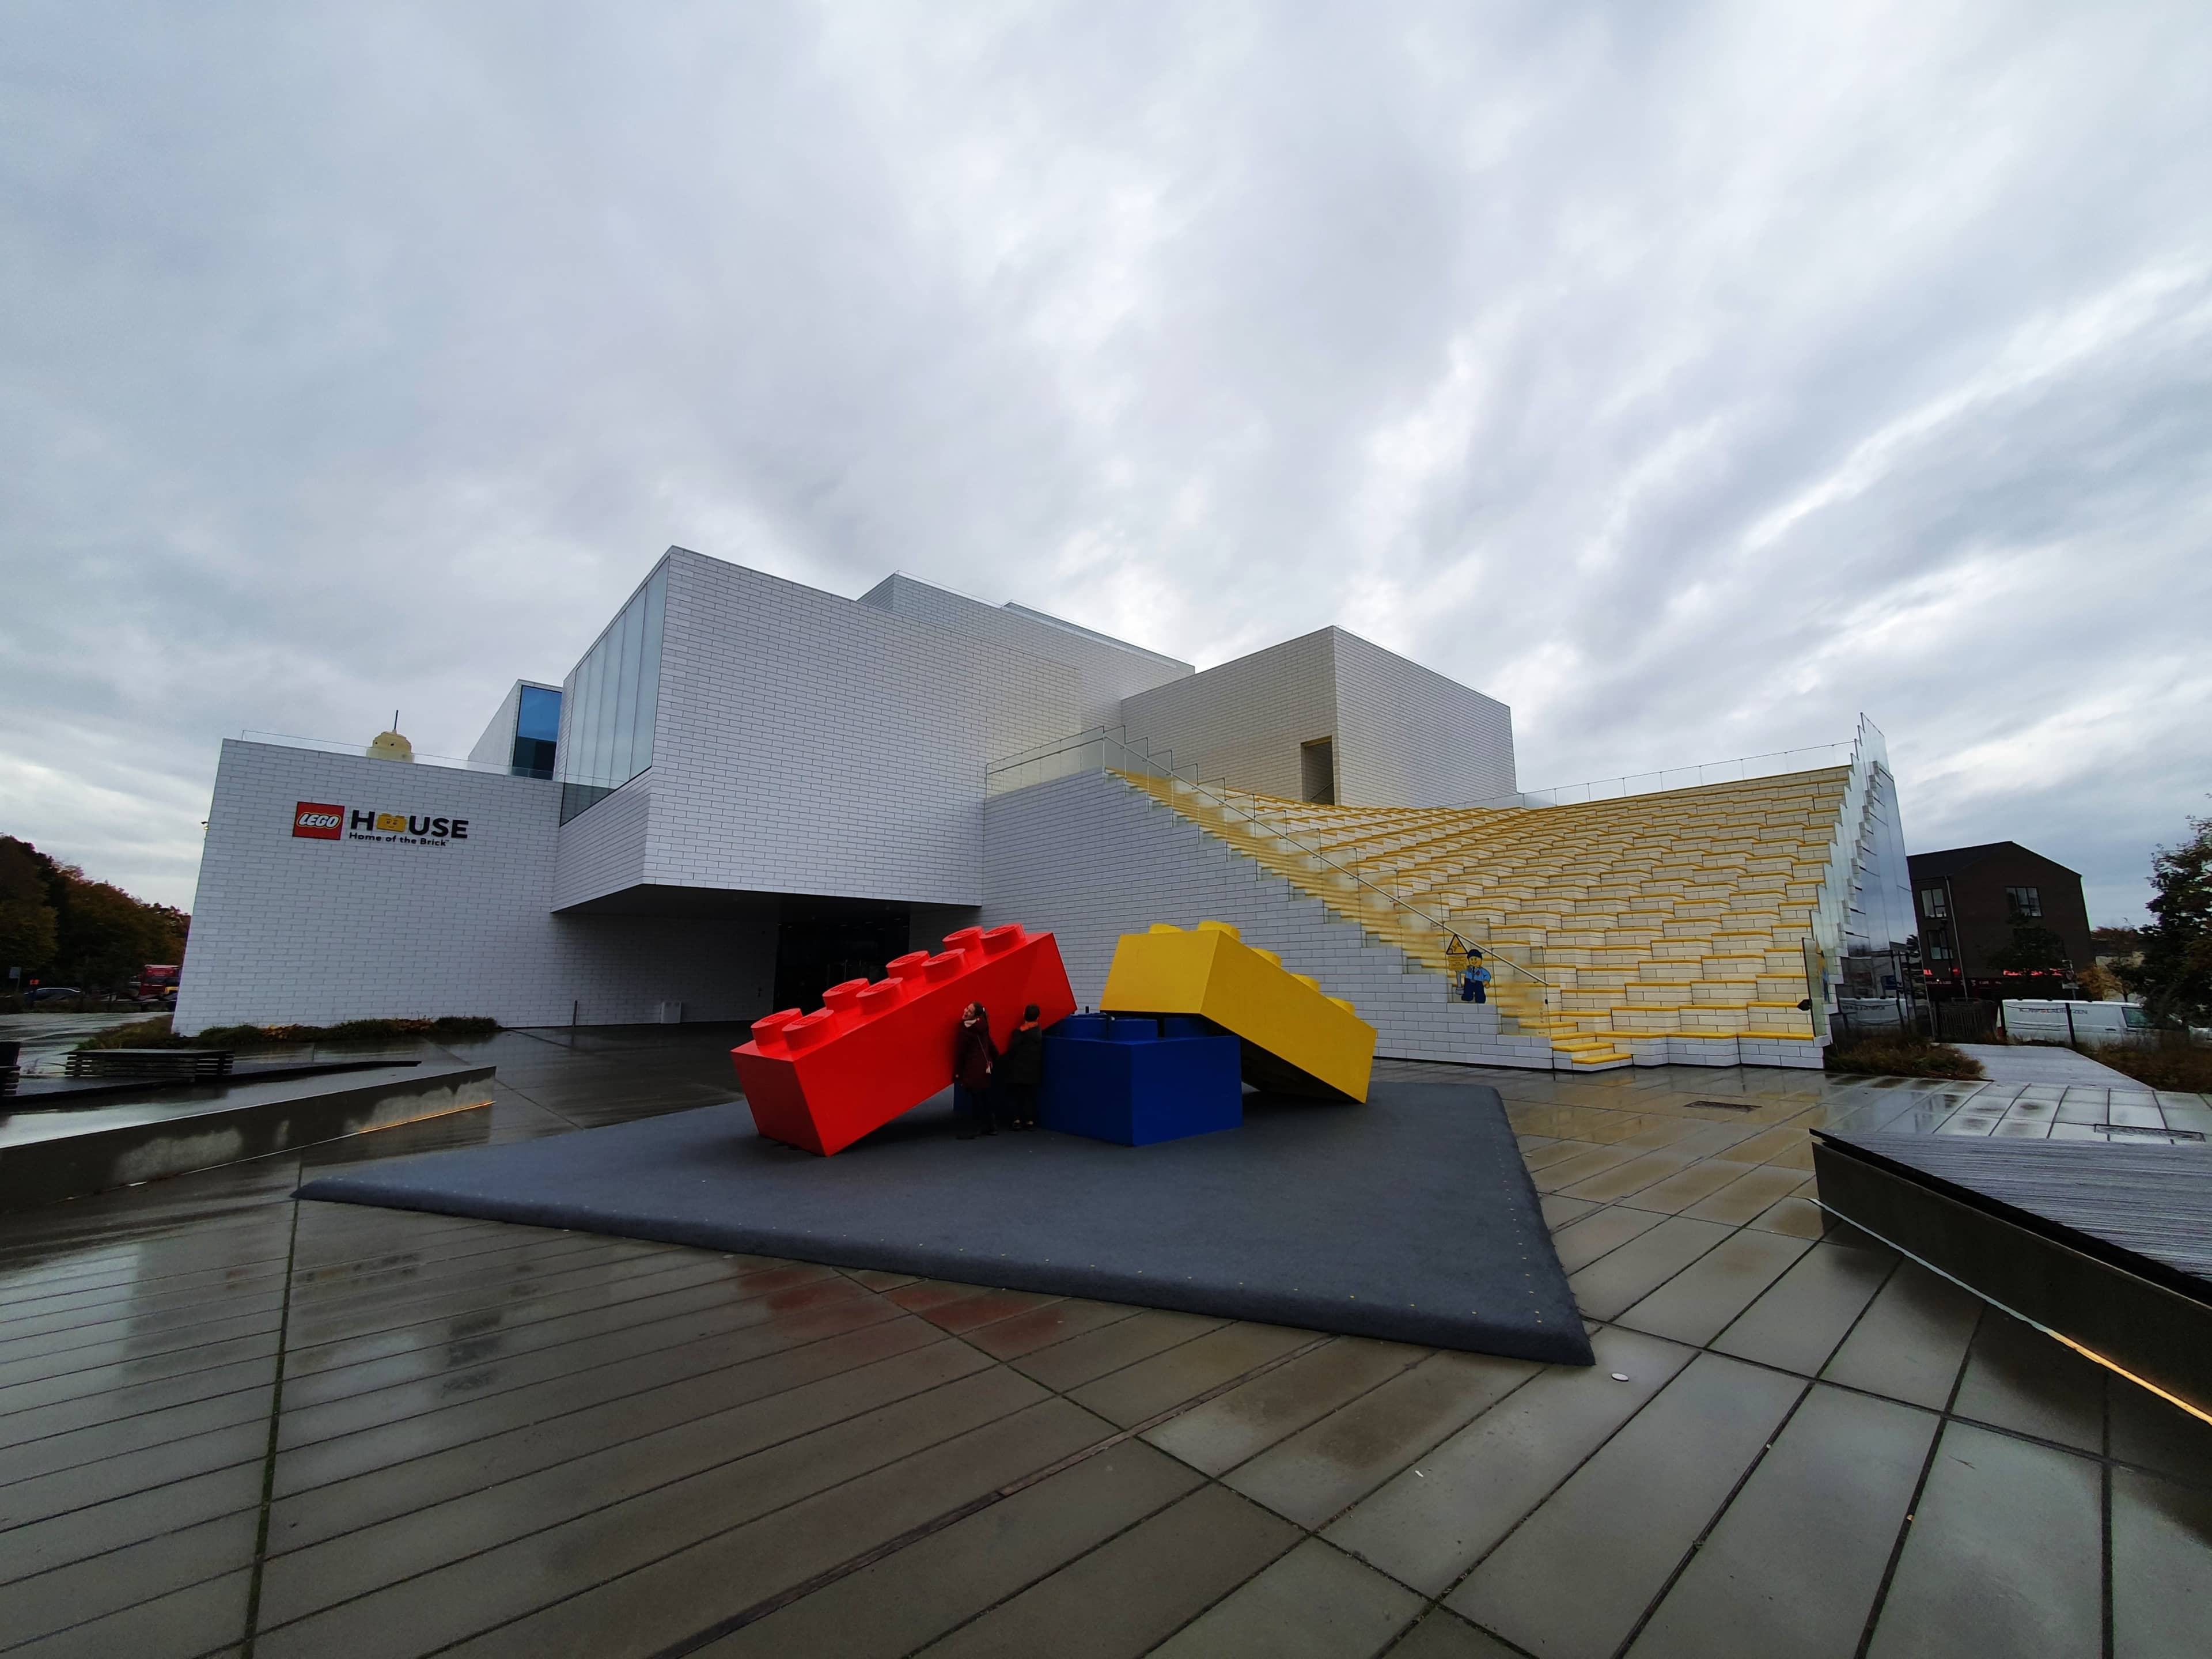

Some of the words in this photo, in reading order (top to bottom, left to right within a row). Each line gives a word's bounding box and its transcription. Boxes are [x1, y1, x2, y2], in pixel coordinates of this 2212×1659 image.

[298, 813, 341, 829] LEGO
[350, 810, 469, 839] HUSE
[349, 832, 381, 842] Home
[385, 835, 396, 843] of
